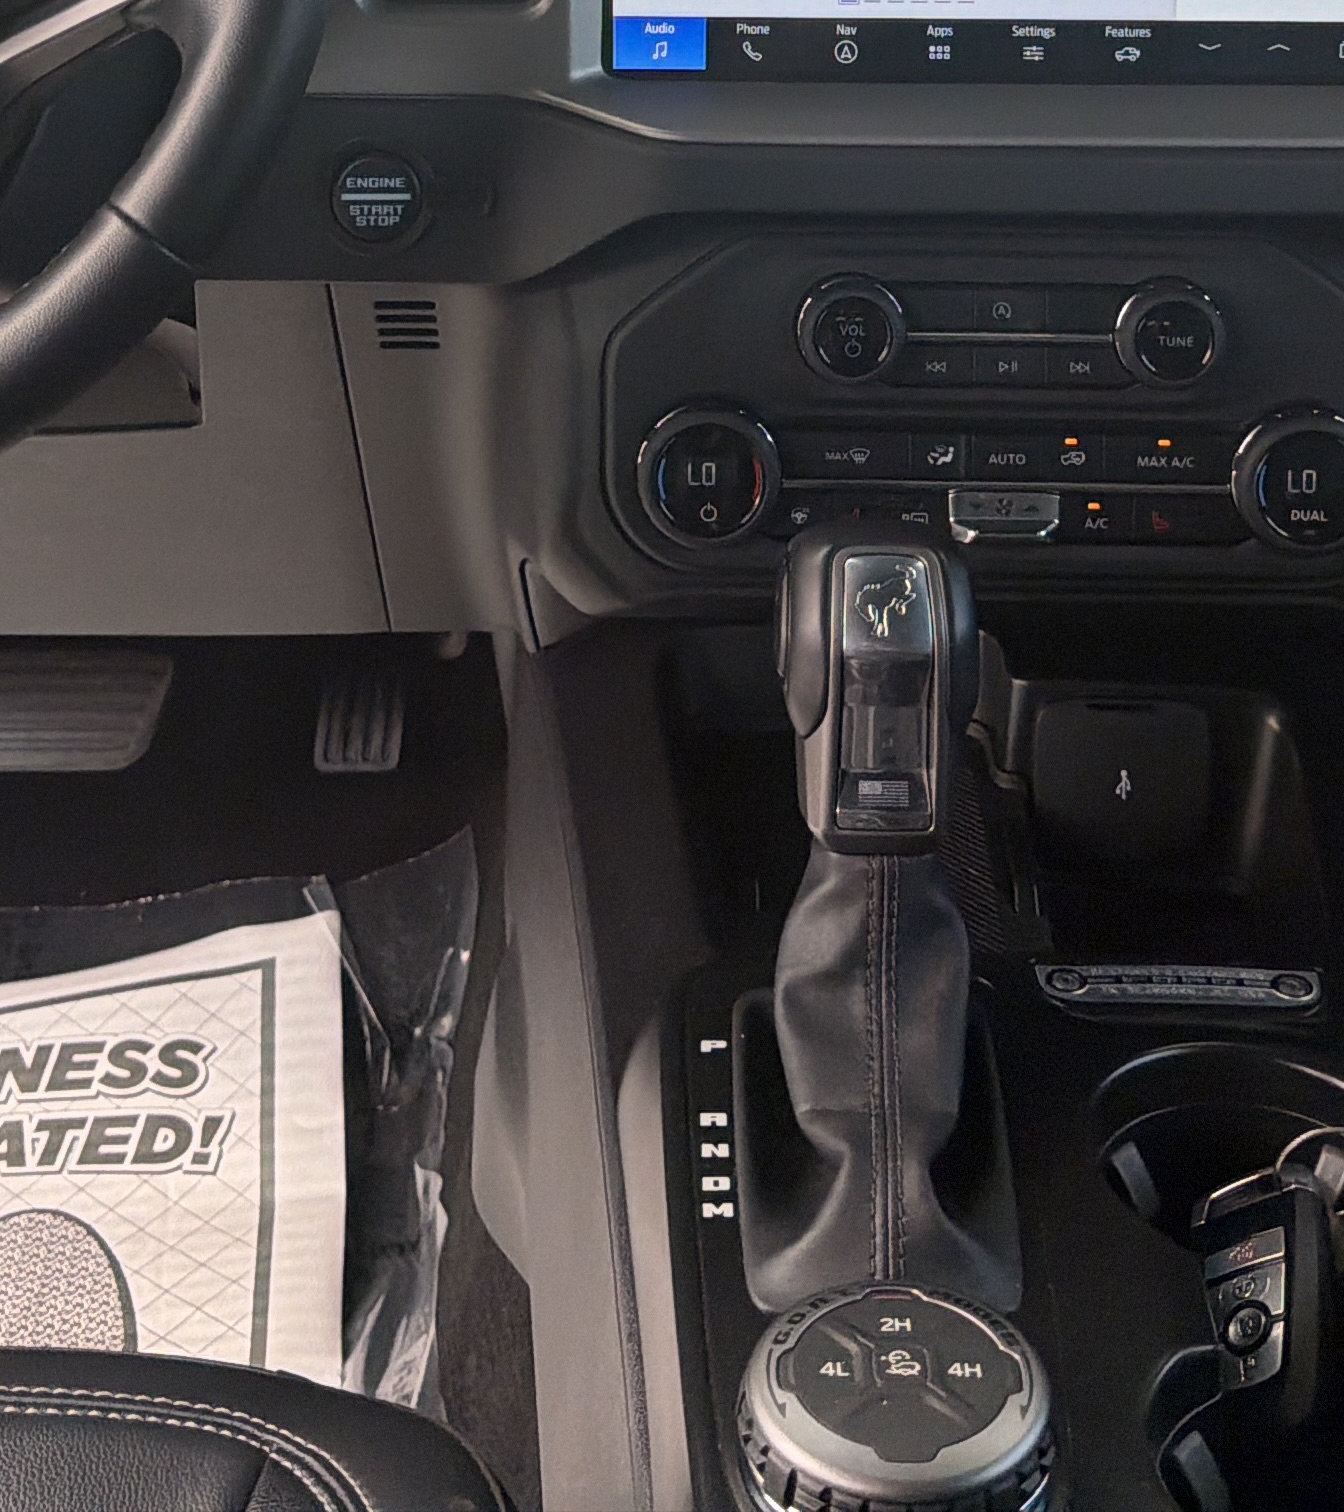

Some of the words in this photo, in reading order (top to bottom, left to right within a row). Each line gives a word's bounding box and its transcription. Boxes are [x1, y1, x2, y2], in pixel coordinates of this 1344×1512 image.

[644, 22, 675, 34] Audio
[736, 23, 770, 35] Phone
[836, 24, 857, 36] Nav
[927, 25, 953, 39] Apps
[1011, 25, 1056, 40] Settings
[1105, 26, 1151, 38] Features
[346, 177, 407, 188] ENGINE
[349, 205, 404, 216] START
[356, 216, 400, 226] STOP
[839, 325, 866, 337] VOL
[1158, 335, 1195, 348] TUNE
[825, 451, 849, 462] MAX
[988, 453, 1026, 465] AUTO
[1137, 456, 1168, 468] MAX
[1171, 456, 1195, 468] A/C
[1290, 509, 1328, 523] DUAL
[1084, 517, 1109, 530] A/C
[700, 1040, 727, 1053] P
[701, 1143, 729, 1157] N
[702, 1176, 730, 1191] D
[702, 1202, 734, 1218] M
[880, 1317, 912, 1332] 2H
[819, 1361, 851, 1377] 4L
[947, 1363, 983, 1378] 4H
